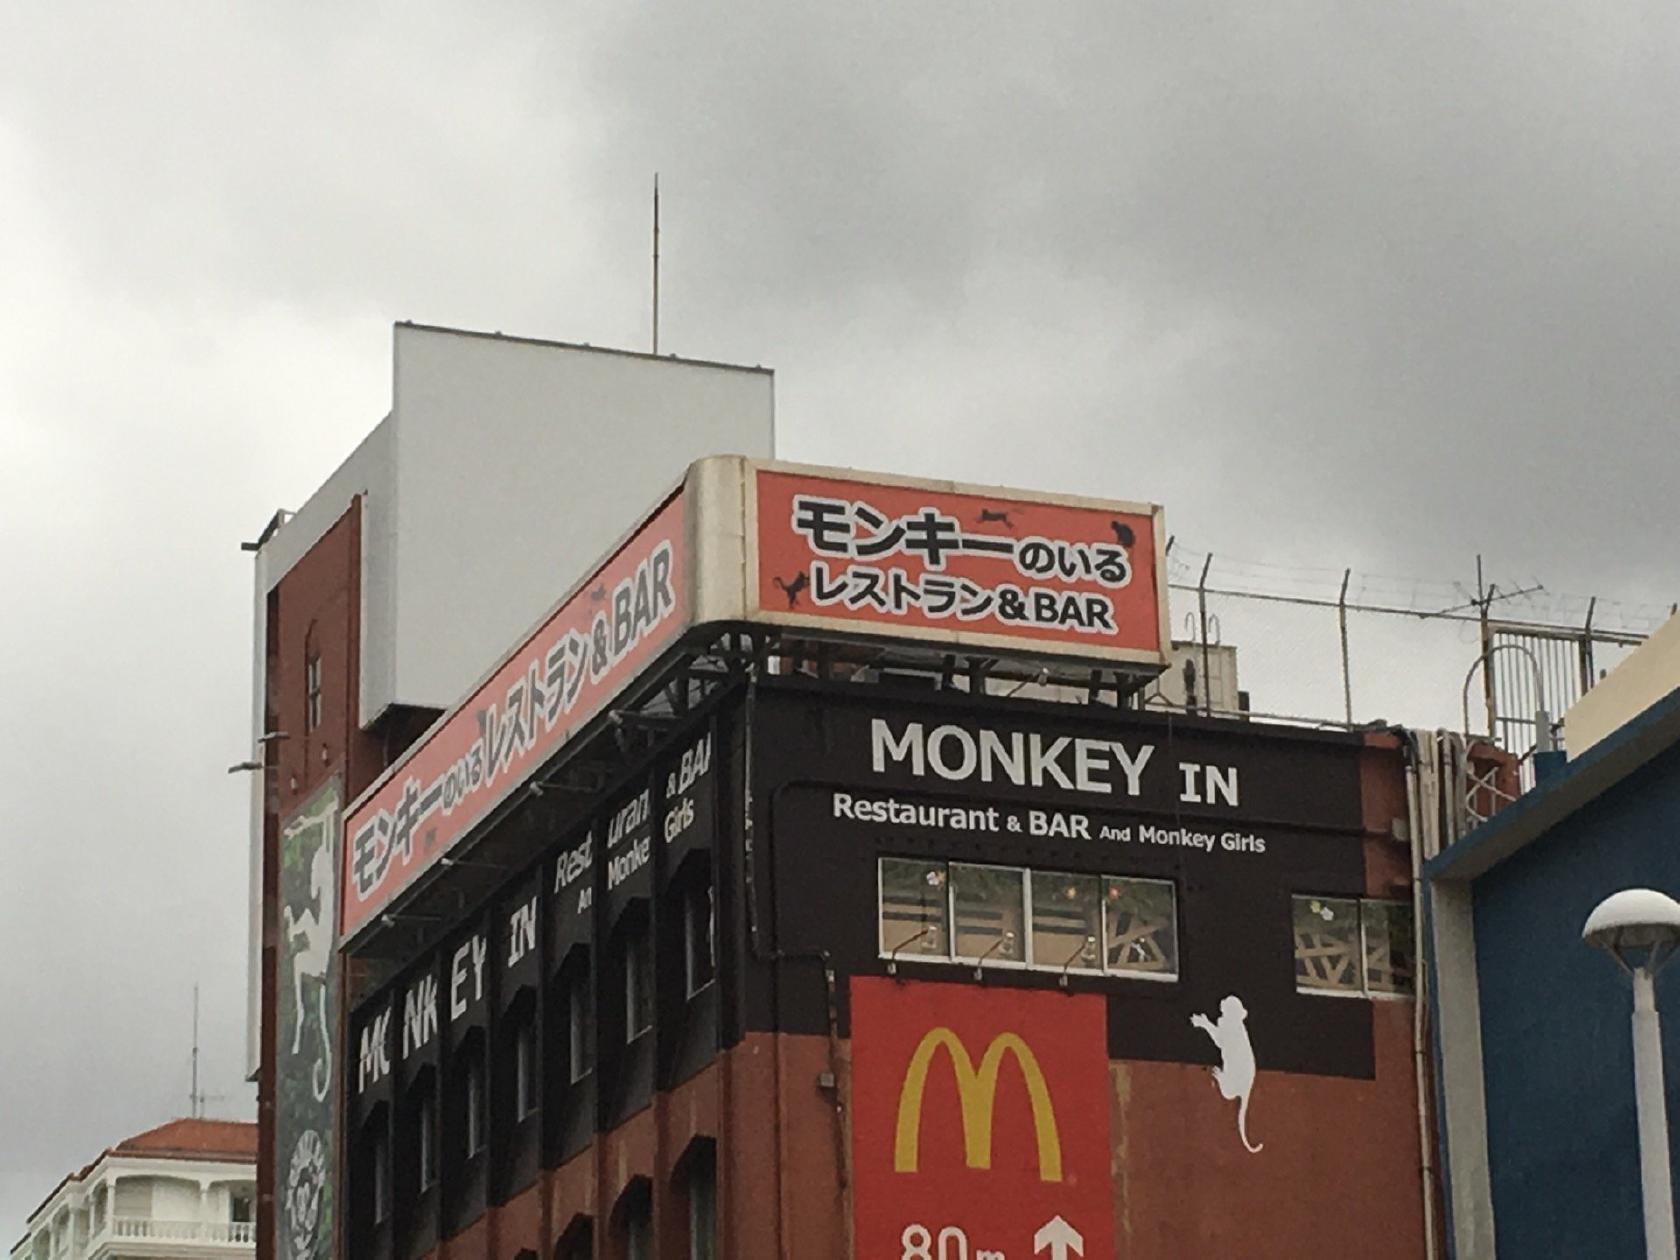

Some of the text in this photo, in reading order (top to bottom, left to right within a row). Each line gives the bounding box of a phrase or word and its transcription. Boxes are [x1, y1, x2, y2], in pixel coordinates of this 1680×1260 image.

[795, 497, 1130, 586] モンキーのいる
[871, 718, 1238, 806] MONKEY IN
[833, 793, 1266, 853] Restaurant & BAR And Monkey Girls
[577, 886, 593, 914] An
[608, 836, 651, 890] Monke
[508, 896, 537, 967] IN
